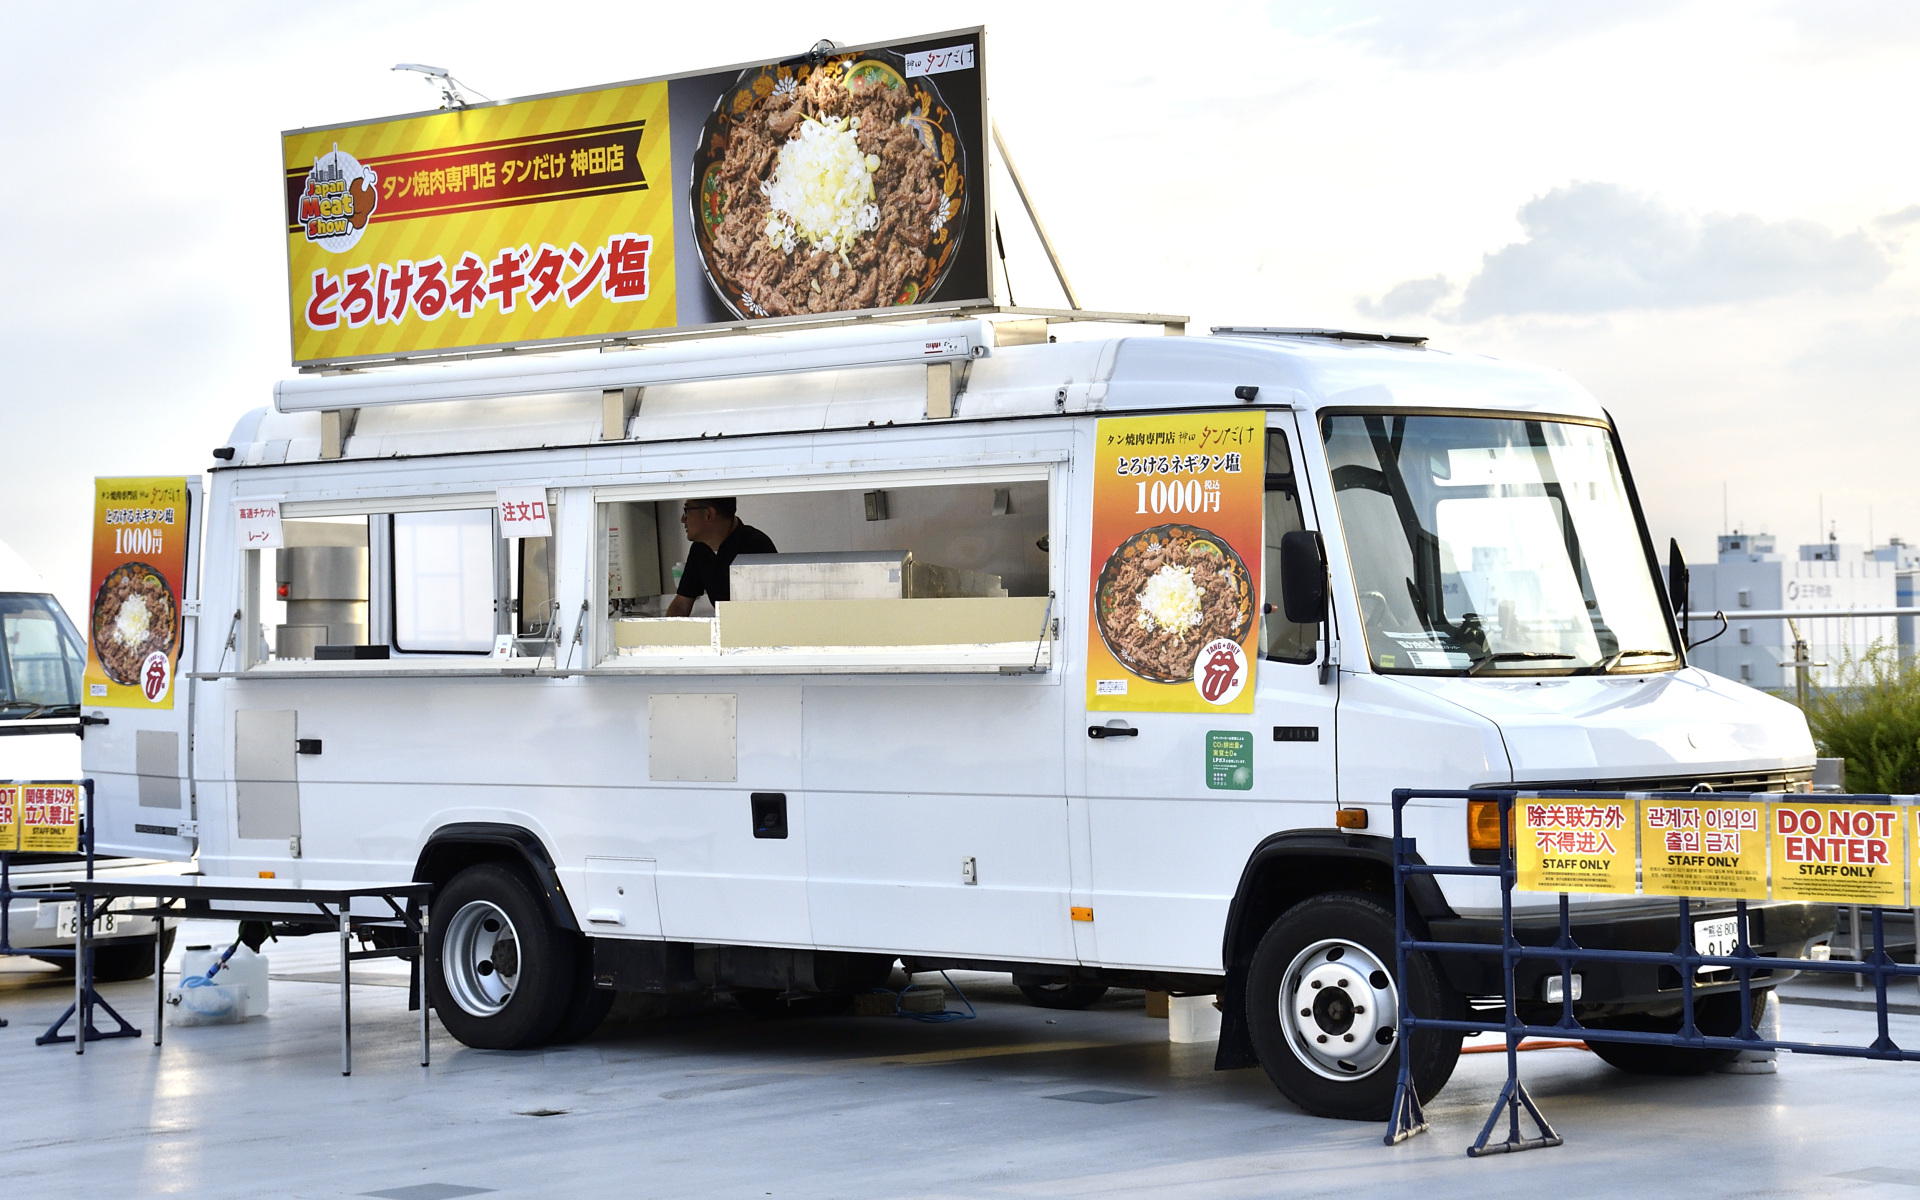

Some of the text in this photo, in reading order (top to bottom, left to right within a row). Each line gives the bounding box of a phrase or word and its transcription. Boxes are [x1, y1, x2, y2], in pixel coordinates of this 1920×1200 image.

[925, 48, 974, 73] タンだけ
[383, 144, 624, 200] タン焼肉専門店 タンだけ 神田店
[308, 181, 345, 198] Japan
[302, 193, 353, 219] Meat
[307, 237, 651, 328] とろけるネギタン塩
[1107, 432, 1175, 446] タン焼肉専門店
[1199, 426, 1254, 449] タンだけ
[1117, 453, 1241, 476] とろけるネギタン塩
[106, 508, 174, 524] とろけるネギタン塩
[502, 501, 545, 522] 注文口
[248, 531, 269, 541] レーン
[0, 788, 16, 805] OT
[25, 788, 75, 804] 関係者以外
[25, 805, 75, 825] 立入禁止
[1527, 805, 1625, 829] 除关联方外
[1648, 808, 1757, 830] 관계자 이외의
[1777, 809, 1896, 837] DO NOT
[32, 827, 66, 835] STAFF ONLY
[1536, 831, 1615, 854] 不得进入
[1666, 832, 1739, 853] 출입 금지
[1786, 837, 1889, 864] ENTER
[1542, 859, 1611, 870] STAFF ONLY
[1667, 855, 1739, 868] STAFF ONLY
[1799, 864, 1875, 878] STAFF ONLY
